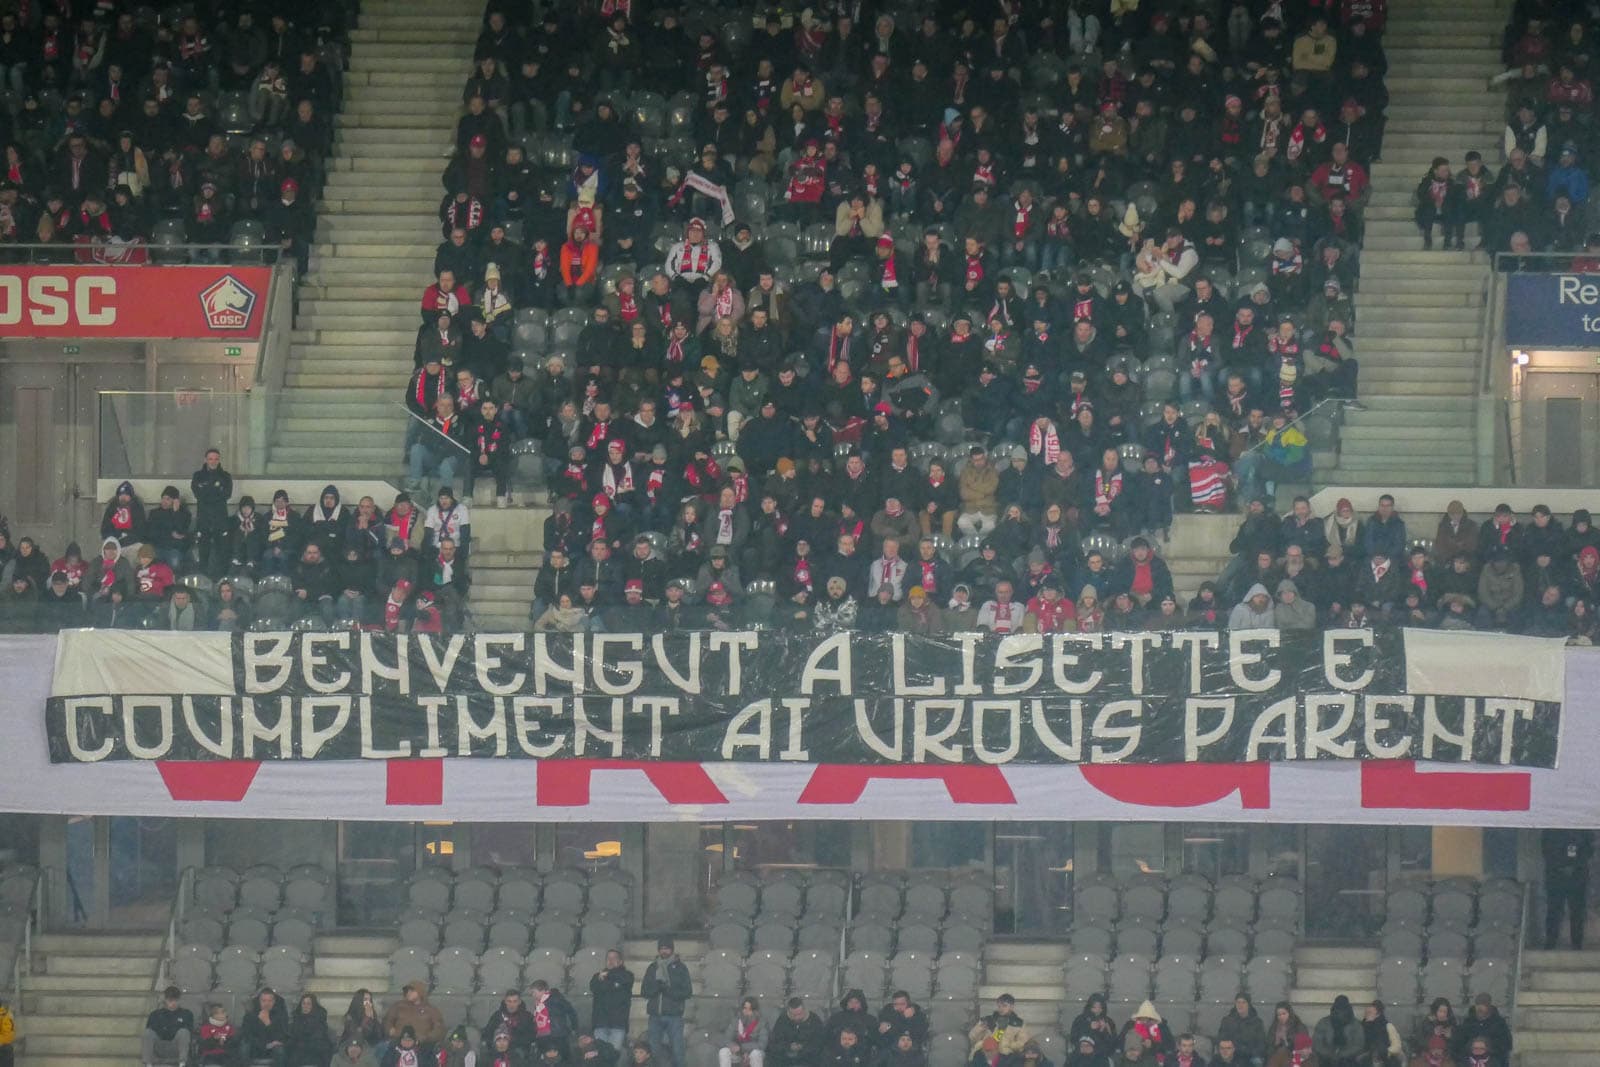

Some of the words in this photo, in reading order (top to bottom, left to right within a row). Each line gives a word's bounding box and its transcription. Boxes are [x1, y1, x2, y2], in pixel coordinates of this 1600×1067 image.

[1560, 276, 1598, 304] Re
[213, 315, 242, 325] LOSC
[801, 631, 851, 695] A
[892, 628, 1282, 696] LISETTE
[1323, 628, 1375, 691] E
[721, 697, 811, 761] AI
[1184, 693, 1535, 764] PARENT
